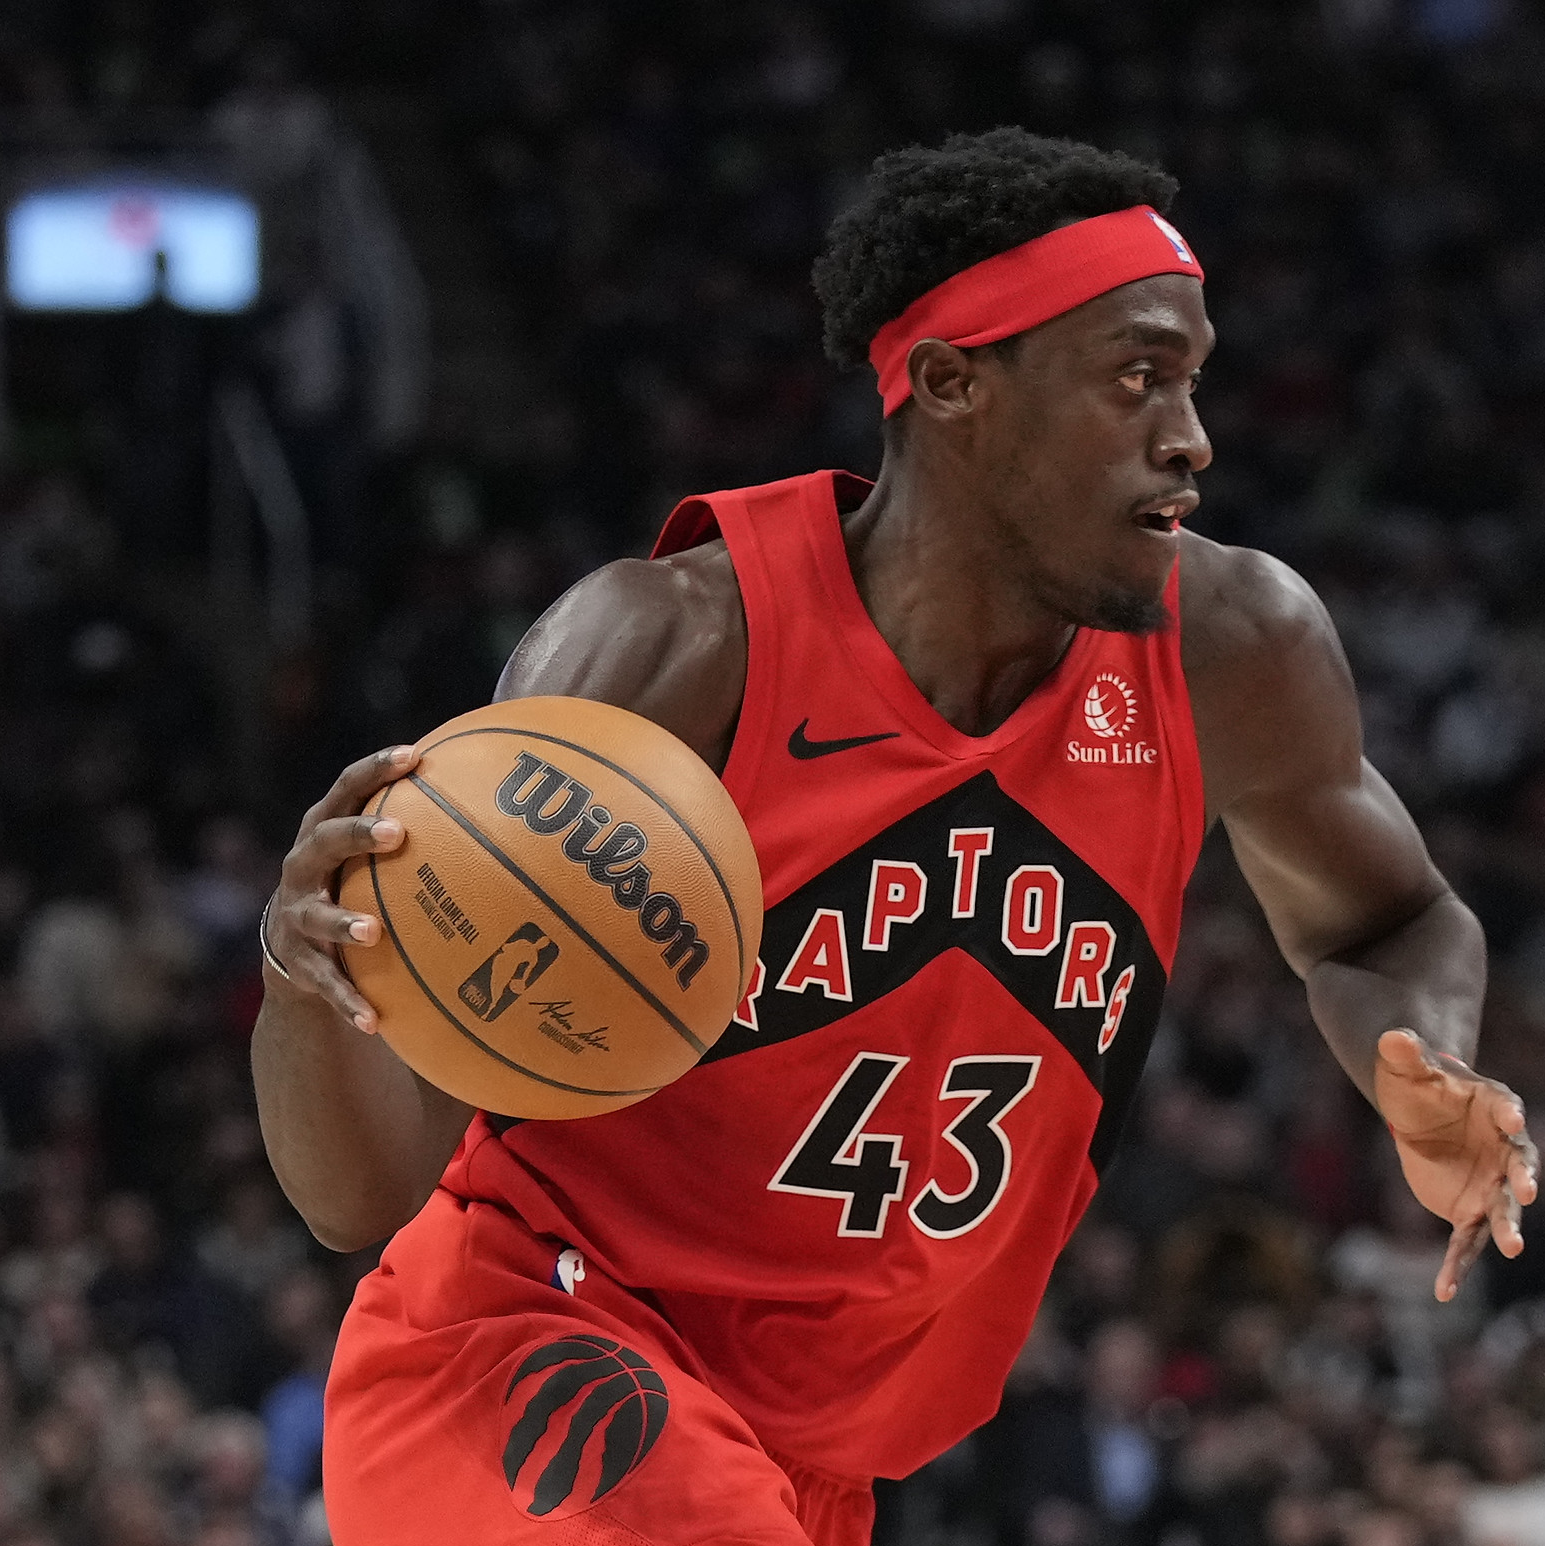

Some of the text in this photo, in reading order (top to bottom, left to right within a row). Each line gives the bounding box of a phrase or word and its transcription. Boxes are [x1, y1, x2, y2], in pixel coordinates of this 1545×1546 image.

[1067, 741, 1157, 764] Sun Life
[416, 862, 480, 945] OFFICIAL GAME BALL
[495, 750, 710, 992] Wilson
[767, 1051, 1042, 1239] 43
